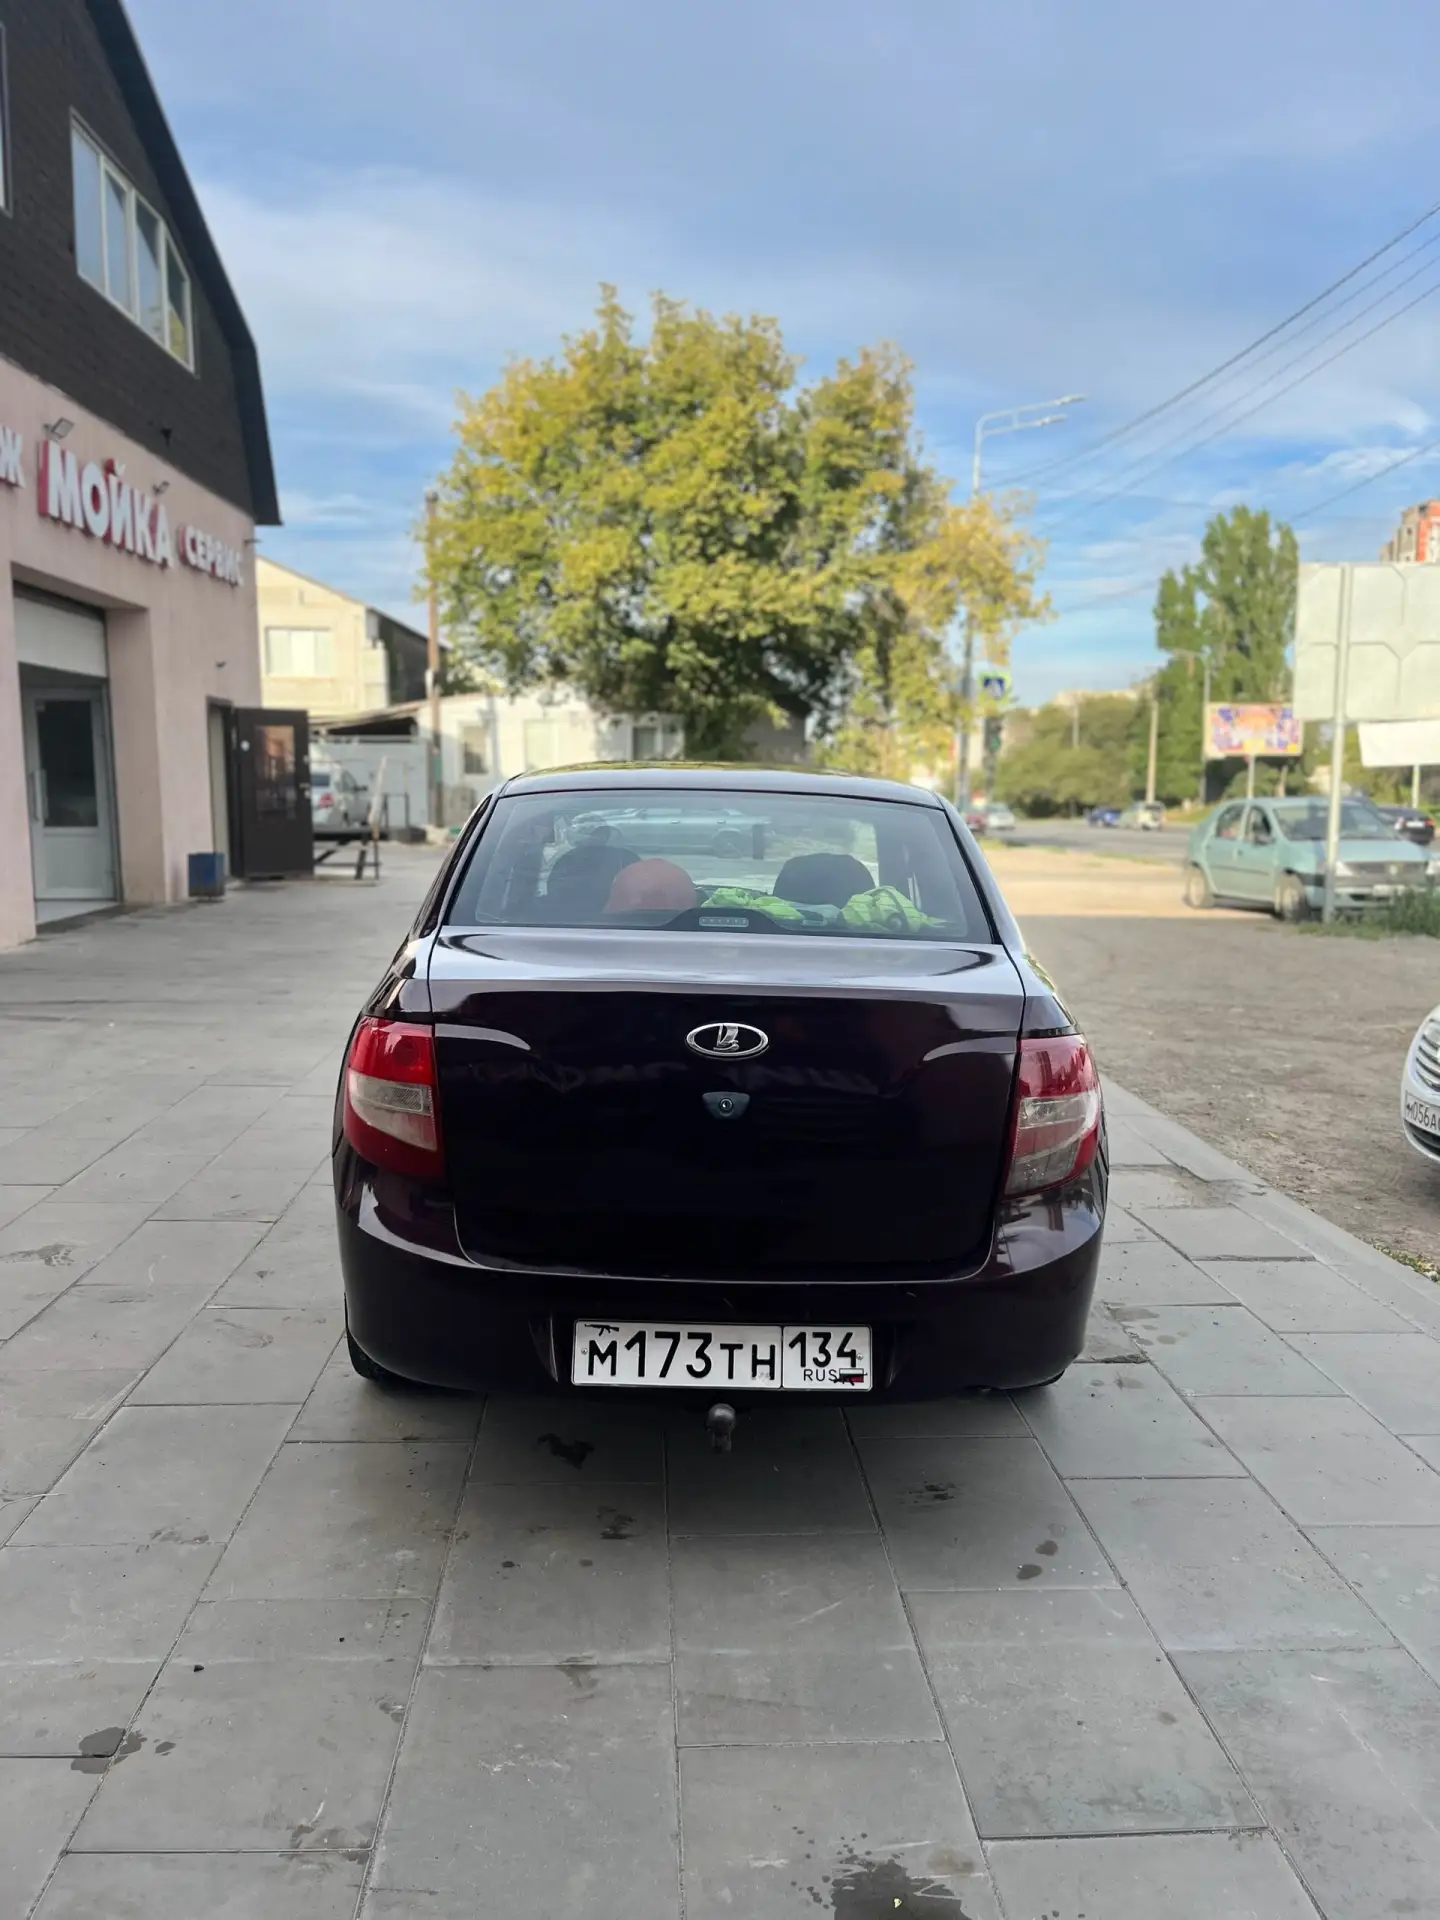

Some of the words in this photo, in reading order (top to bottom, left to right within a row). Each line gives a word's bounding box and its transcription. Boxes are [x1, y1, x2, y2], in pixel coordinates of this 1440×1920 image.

[44, 439, 174, 569] МОЙКА
[183, 525, 245, 587] СЕРВИС
[588, 1330, 776, 1380] М173ТН
[788, 1331, 857, 1368] 134
[803, 1368, 839, 1382] RUS
